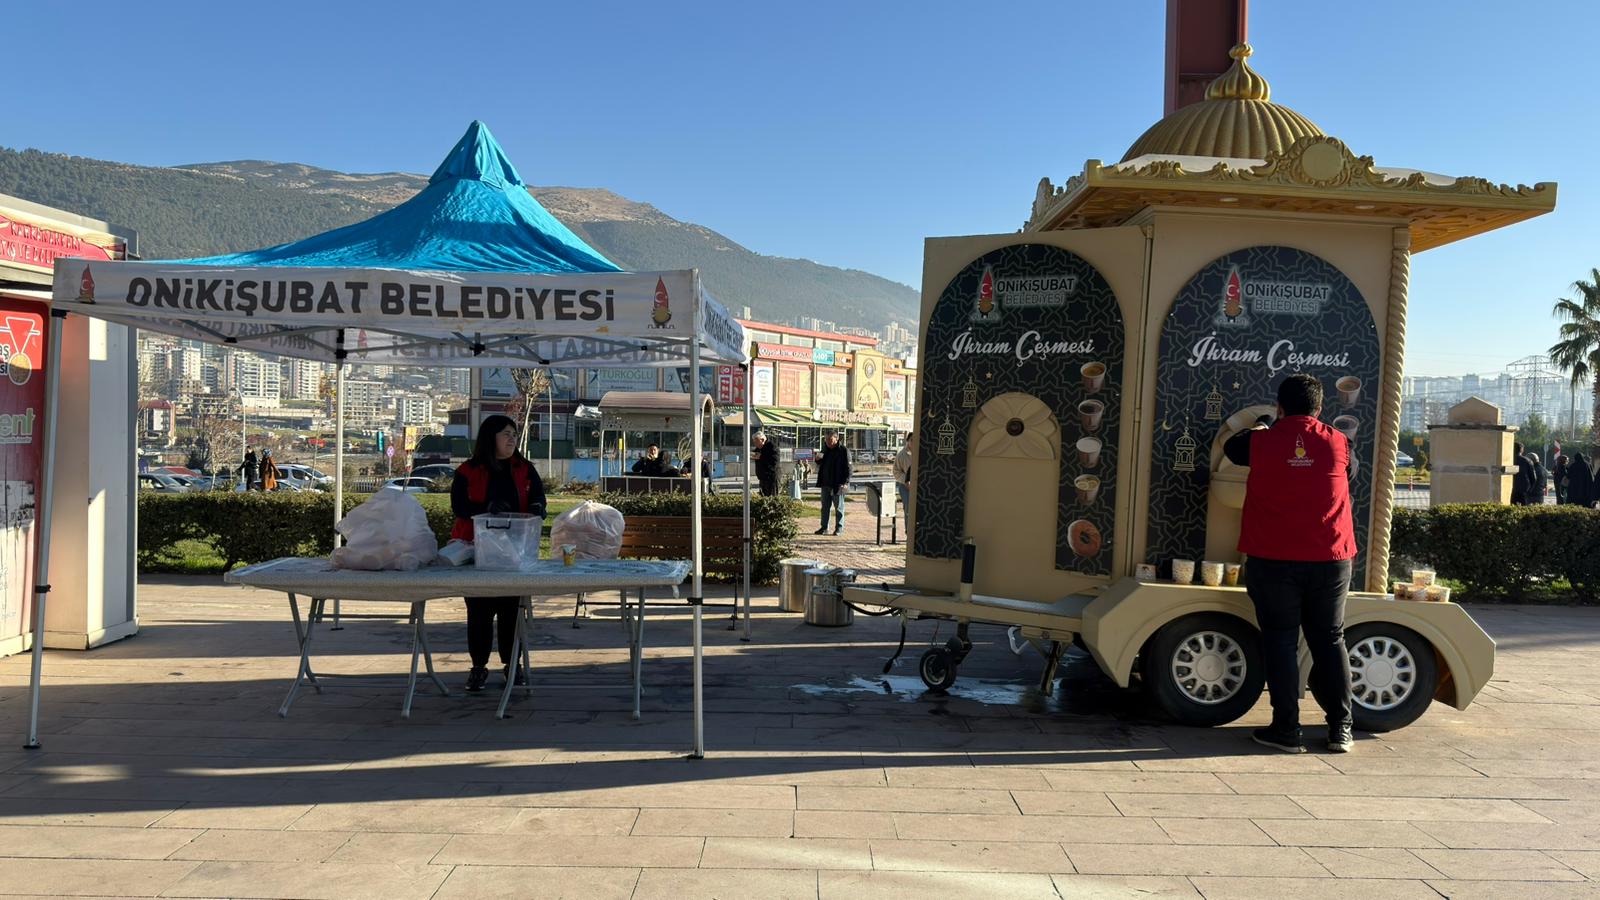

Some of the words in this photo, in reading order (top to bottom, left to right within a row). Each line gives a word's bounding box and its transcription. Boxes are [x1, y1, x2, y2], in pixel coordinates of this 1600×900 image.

[948, 326, 1011, 361] İkram
[1015, 330, 1095, 367] Çeşmesi
[1187, 331, 1262, 367] İkram
[1266, 339, 1350, 377] Çeşmesi
